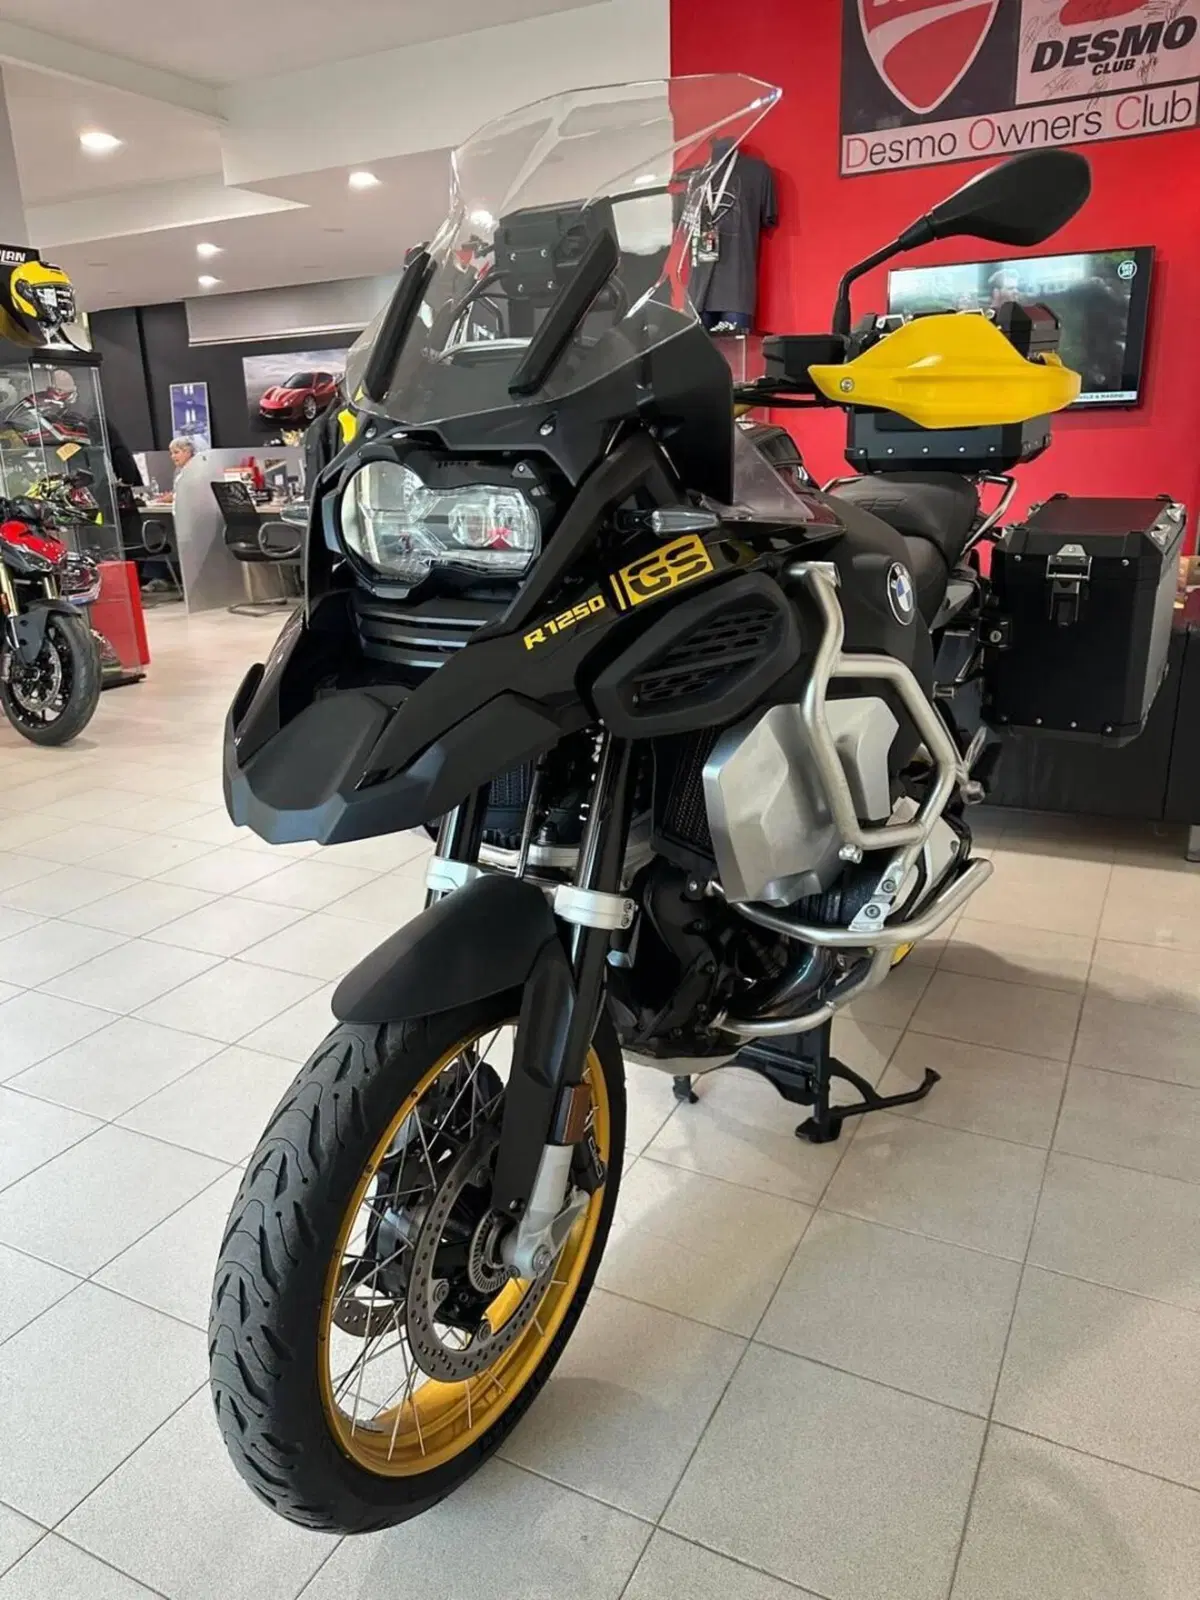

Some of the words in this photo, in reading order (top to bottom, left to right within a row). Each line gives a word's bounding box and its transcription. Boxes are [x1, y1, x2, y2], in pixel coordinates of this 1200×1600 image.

[1030, 16, 1198, 73] DESMO
[1091, 57, 1135, 75] CLUB
[845, 132, 957, 168] Desmo
[968, 110, 1102, 150] Owners
[1115, 91, 1192, 130] Club
[523, 628, 547, 650] R
[544, 594, 606, 635] 1250
[627, 541, 707, 596] GS
